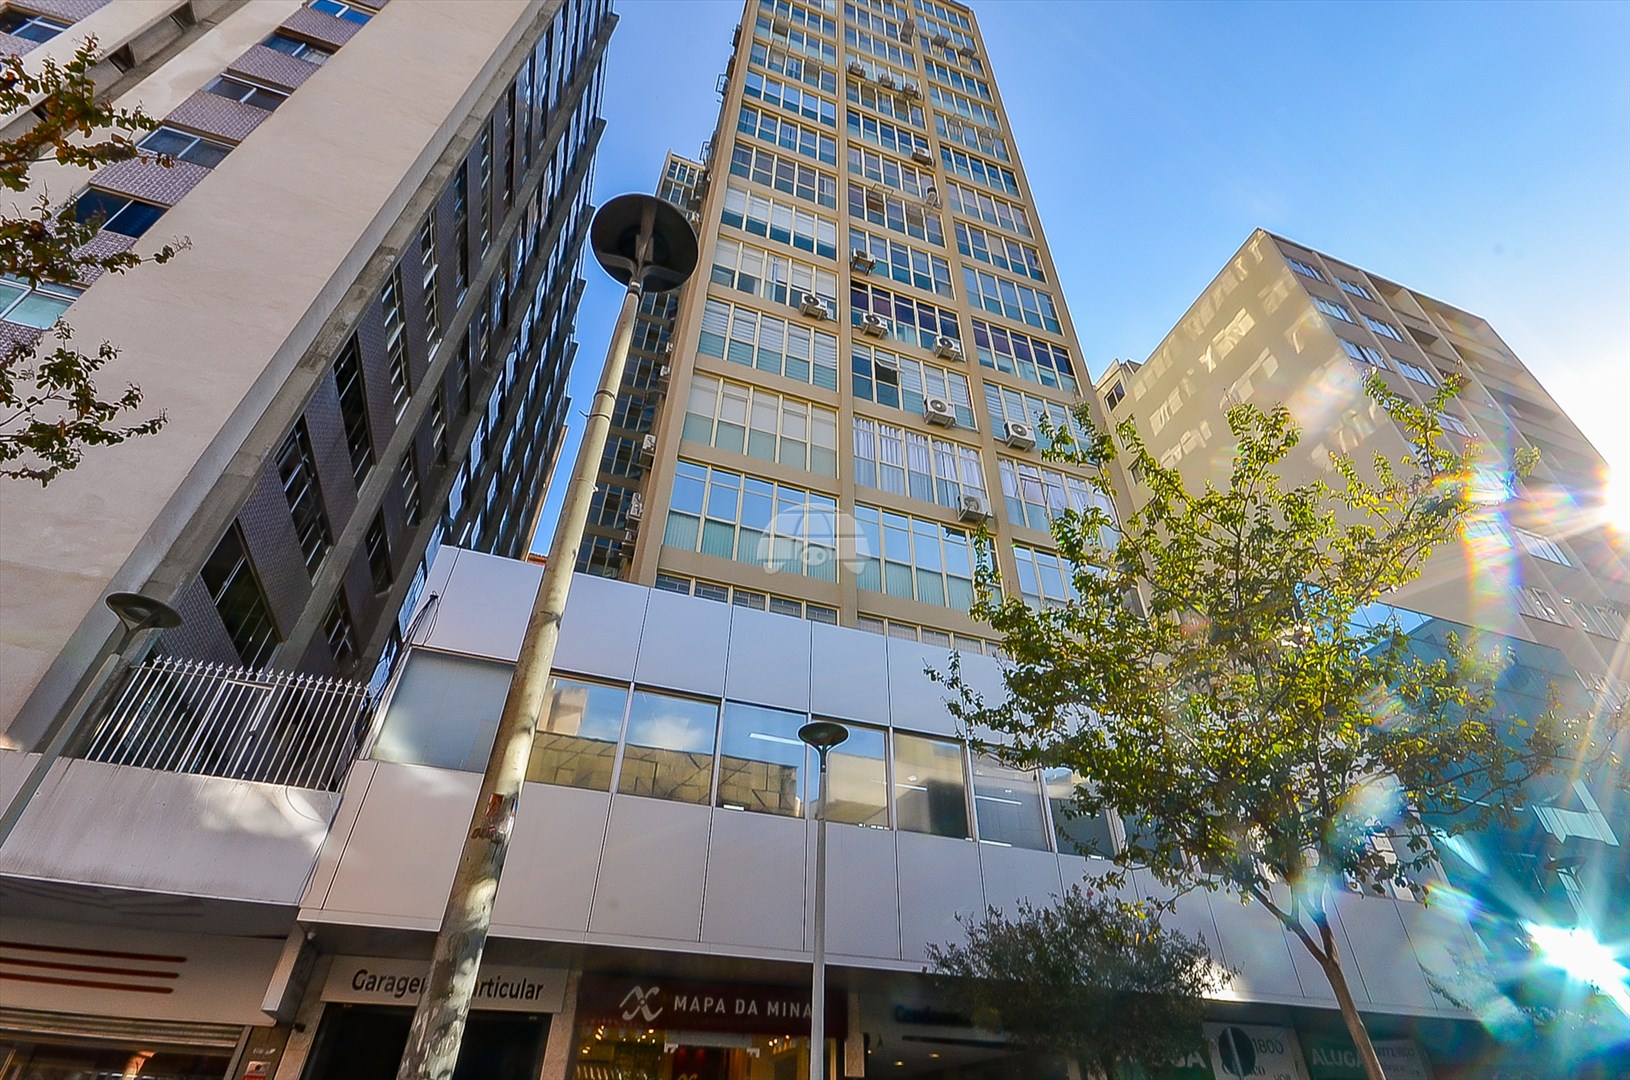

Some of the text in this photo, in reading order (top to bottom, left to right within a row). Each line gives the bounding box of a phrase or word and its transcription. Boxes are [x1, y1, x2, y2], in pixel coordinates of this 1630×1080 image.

[674, 995, 812, 1019] MAPA DA MINA
